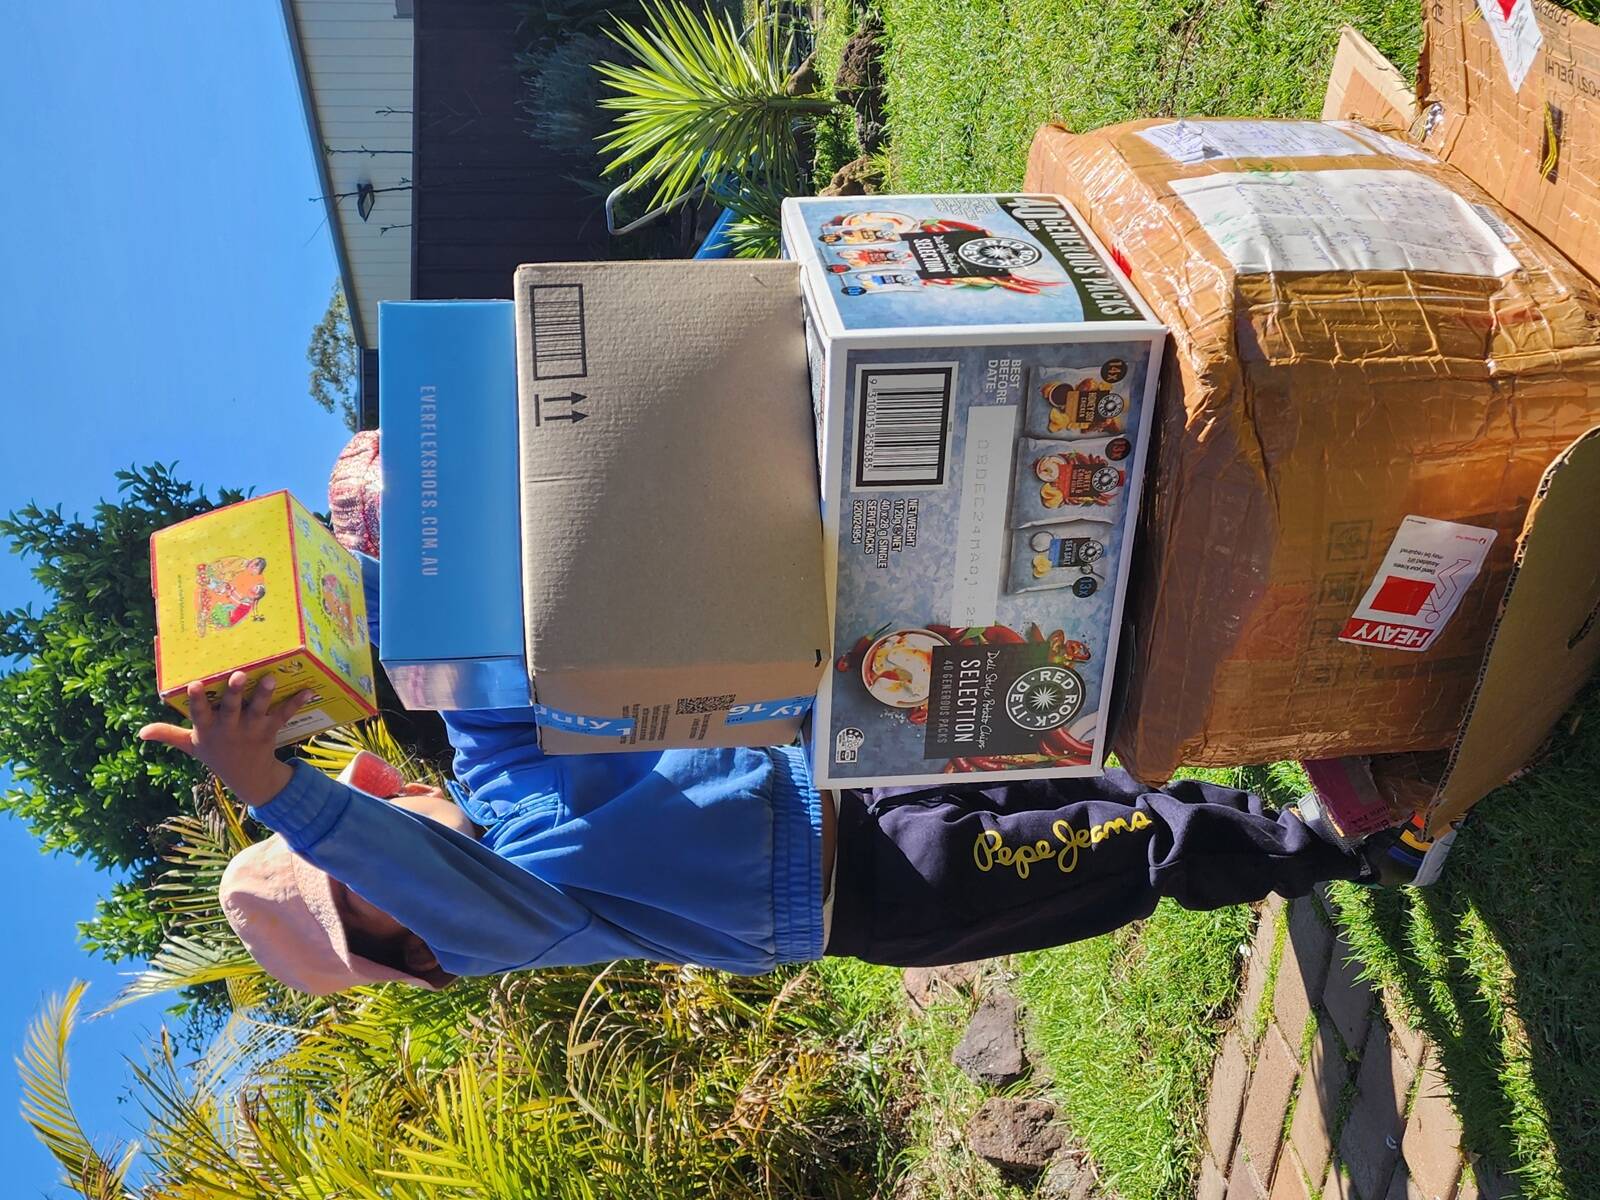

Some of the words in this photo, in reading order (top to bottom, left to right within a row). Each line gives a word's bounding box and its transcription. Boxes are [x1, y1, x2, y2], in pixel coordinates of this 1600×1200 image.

[913, 238, 947, 273] SELECTION
[964, 244, 987, 263] DELI
[1006, 198, 1067, 220] 40
[1041, 219, 1106, 274] GENEROUS
[1080, 278, 1135, 315] PACKS
[984, 359, 998, 393] DATE:
[995, 359, 1010, 405] BEFORE
[1009, 359, 1022, 389] BEST
[866, 392, 877, 429] 310015
[864, 433, 874, 469] 250385
[420, 385, 439, 576] EVERFLEXSHOES.COM.AU
[866, 500, 877, 527] SERVE
[880, 500, 891, 510] 40
[891, 500, 905, 524] 1120g
[907, 499, 918, 515] NET
[852, 500, 863, 544] 320024954
[880, 519, 889, 529] 28
[905, 516, 918, 547] WEIGHT
[864, 527, 875, 554] PACKS
[877, 539, 888, 568] SINGLE
[891, 535, 903, 552] NET
[1078, 578, 1092, 596] 13x
[1352, 622, 1430, 646] HEAVY
[943, 660, 954, 671] 40
[986, 650, 1001, 671] Deli
[980, 673, 998, 698] Style
[1039, 670, 1075, 690] RED
[939, 673, 953, 716] GENEROUS
[953, 659, 981, 743] SELECTION
[1010, 680, 1031, 720] DELI
[980, 699, 996, 725] Potato
[1033, 694, 1078, 727] ROCK
[936, 718, 949, 744] PACKS
[975, 725, 992, 750] Chips
[973, 829, 1057, 880] Pepe
[1052, 811, 1153, 873] Jeans
